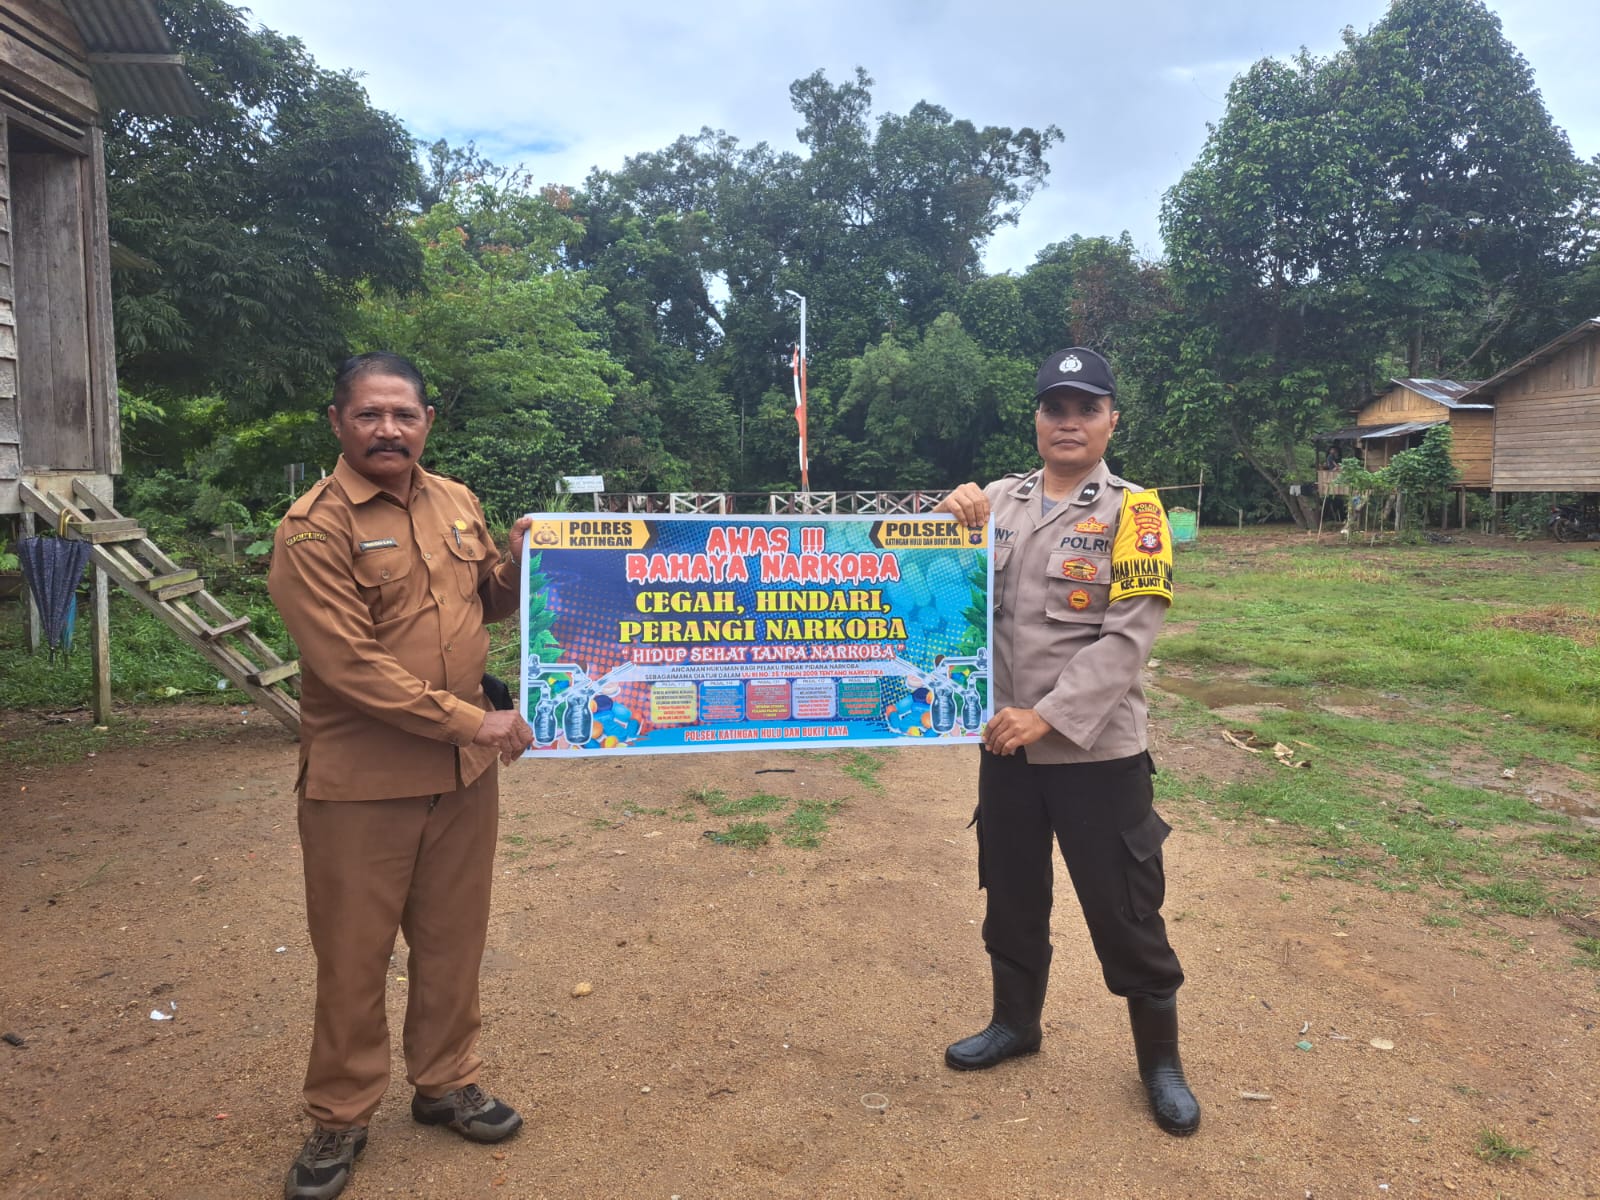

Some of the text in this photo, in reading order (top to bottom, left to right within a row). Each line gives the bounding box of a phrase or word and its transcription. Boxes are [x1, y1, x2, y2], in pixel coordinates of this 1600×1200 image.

[569, 522, 633, 535] POLRES
[886, 522, 960, 537] POLSEK
[994, 528, 1014, 541] NY
[569, 537, 633, 547] KATINGAN
[706, 527, 825, 556] AWAS !!!
[1060, 536, 1109, 552] POLRI
[625, 552, 901, 585] BAHAYA NARKOBA
[635, 589, 892, 614] CEGAH, HINDARI,
[618, 617, 908, 643] PERANGI NARKOBA
[633, 647, 687, 662] HIDUP
[690, 646, 748, 662] SEHAT
[752, 645, 806, 661] TANPA
[810, 644, 896, 660] NARKOBA
[685, 725, 849, 742] POLSEK KATINGAN HULU DAN BUKIT RAYA
